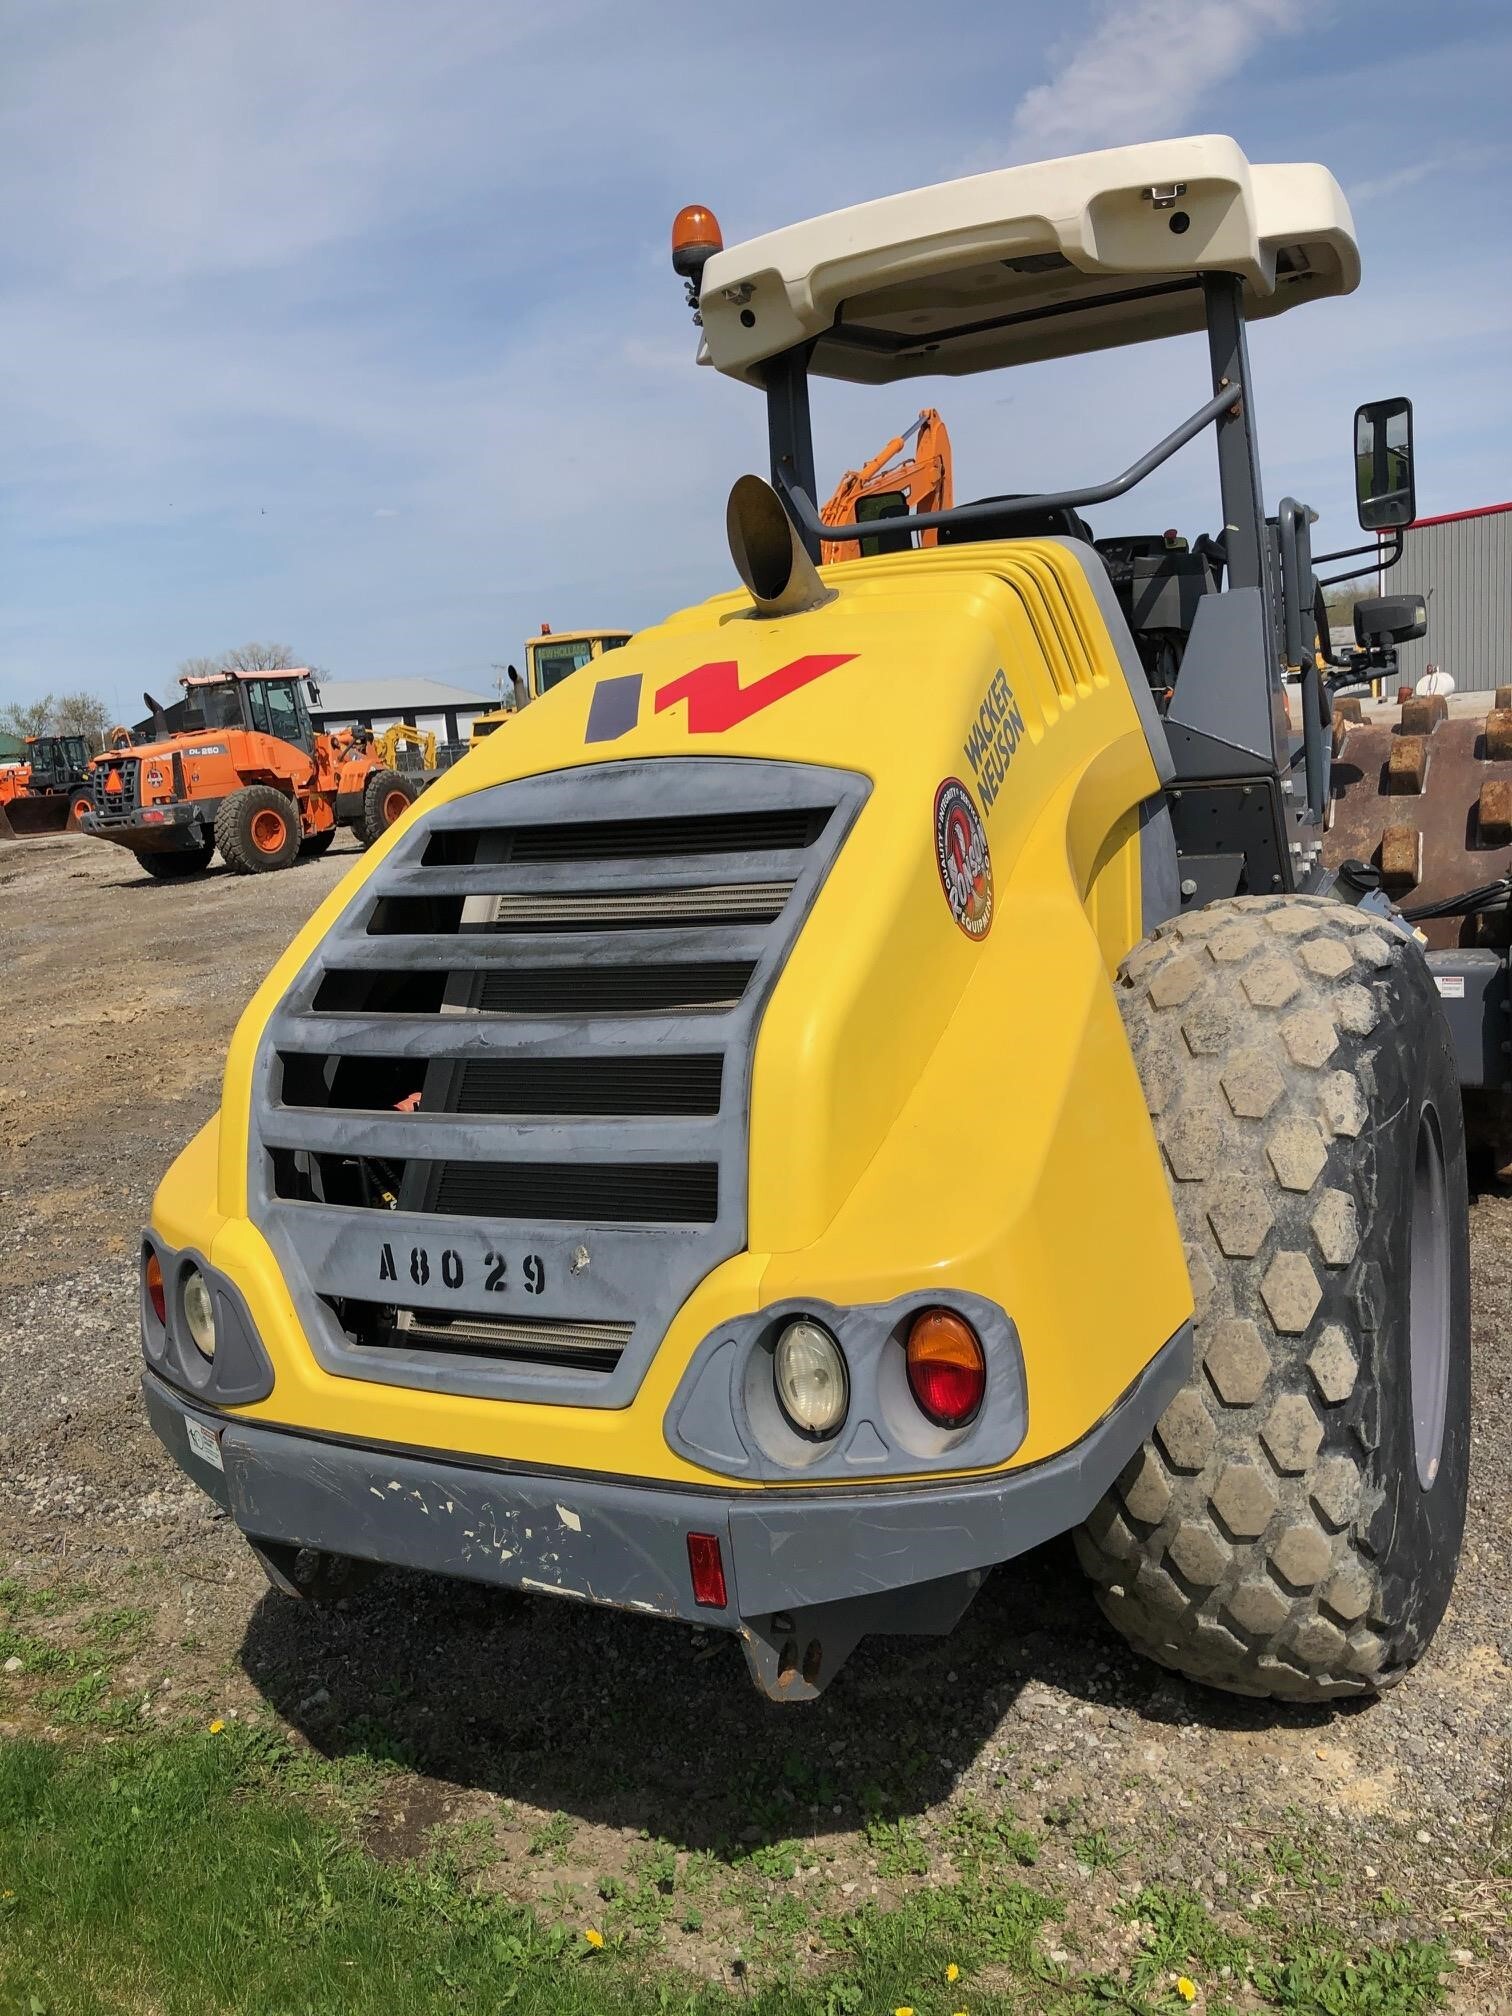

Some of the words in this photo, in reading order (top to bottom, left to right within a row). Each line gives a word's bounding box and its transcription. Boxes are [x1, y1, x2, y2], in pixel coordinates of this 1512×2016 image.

[963, 668, 1013, 775] WACKER
[977, 700, 1025, 818] NEUSON
[938, 787, 957, 823] INTEGRITY
[938, 831, 951, 889] QUALITY
[949, 817, 987, 924] RONSON
[961, 886, 992, 933] EQUIPMENT
[379, 1243, 545, 1295] A8029
